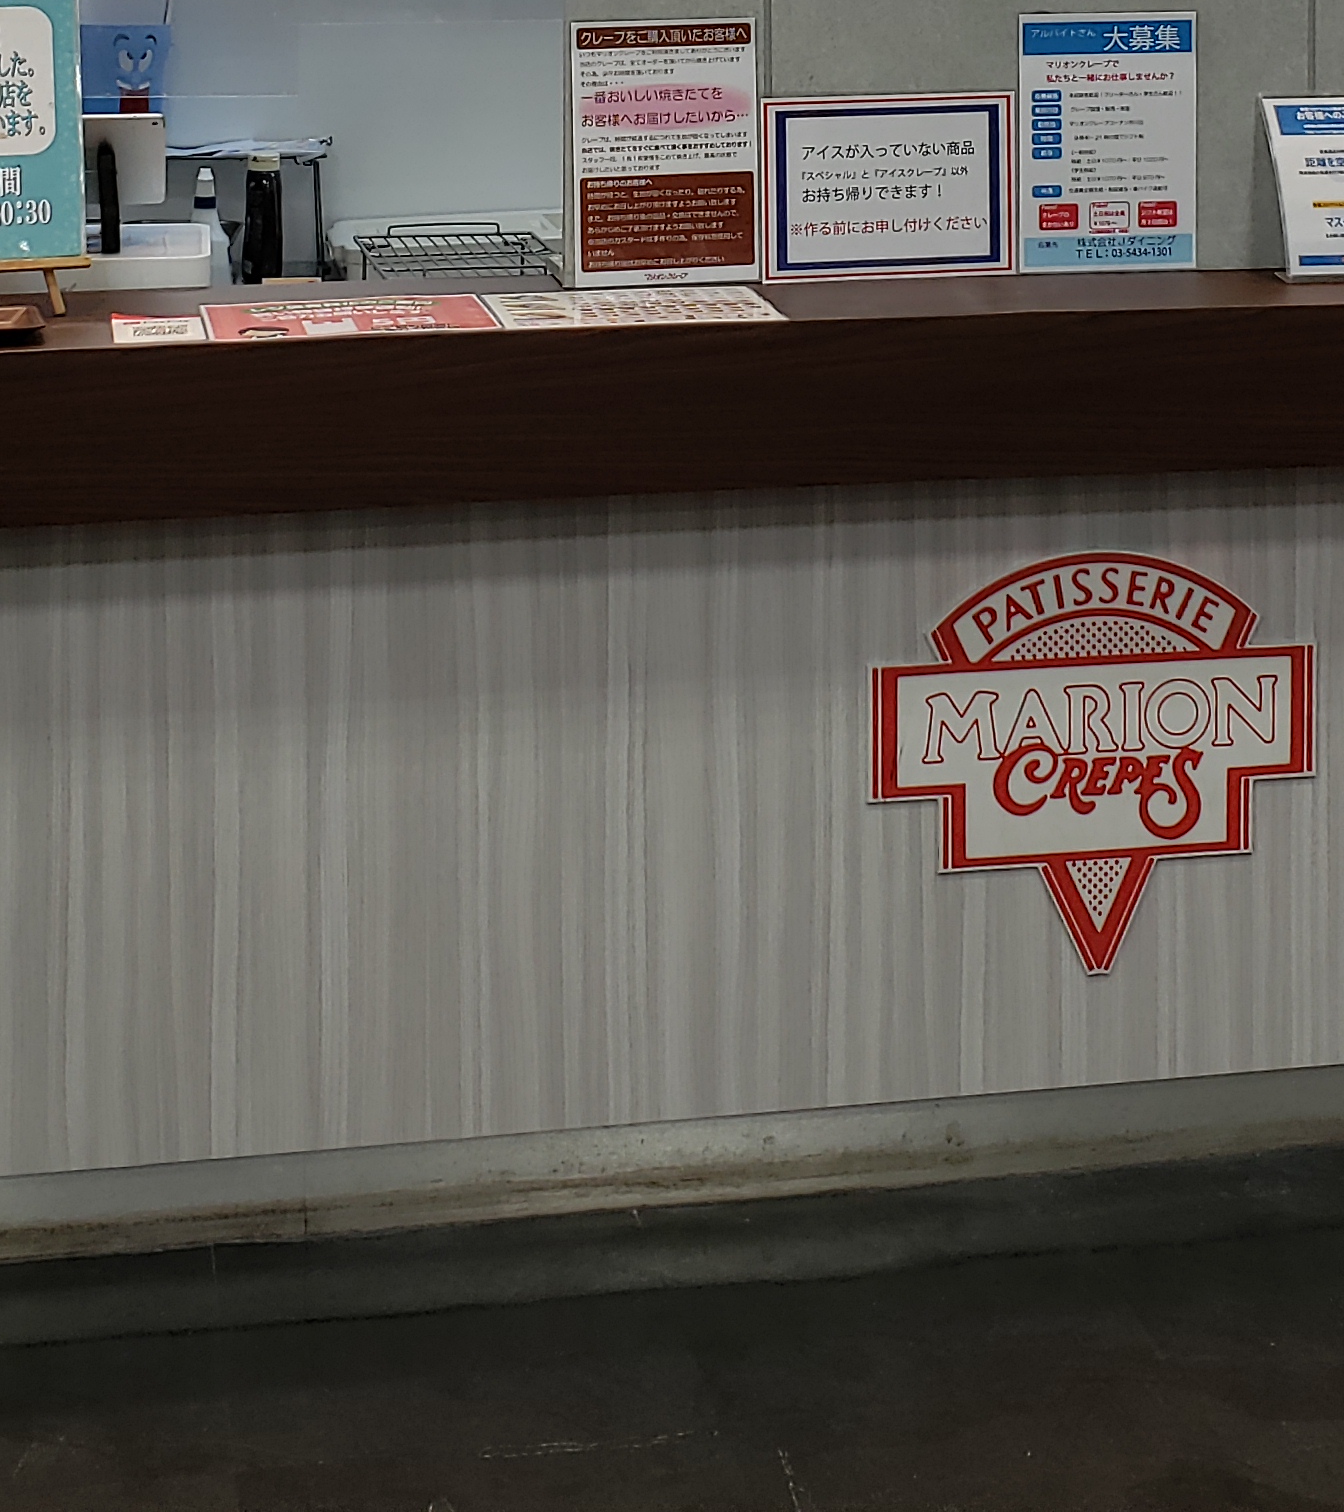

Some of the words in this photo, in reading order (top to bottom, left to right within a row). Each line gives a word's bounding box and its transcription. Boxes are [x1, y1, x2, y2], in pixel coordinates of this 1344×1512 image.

[1102, 25, 1181, 51] 大募集
[1045, 59, 1120, 69] マリオンクレープで
[580, 87, 723, 104] 一番おいしい焼きたてを
[801, 140, 975, 161] アイスが入っていない商品
[861, 169, 870, 179] と
[801, 184, 943, 204] お持ち帰りできます！
[790, 216, 988, 237] ※作る前にお申し付けください
[1111, 246, 1173, 258] 03-5434-1301
[971, 567, 1220, 645] PATISSERIE
[921, 674, 1278, 765] MARION
[992, 742, 1204, 840] CREPES
